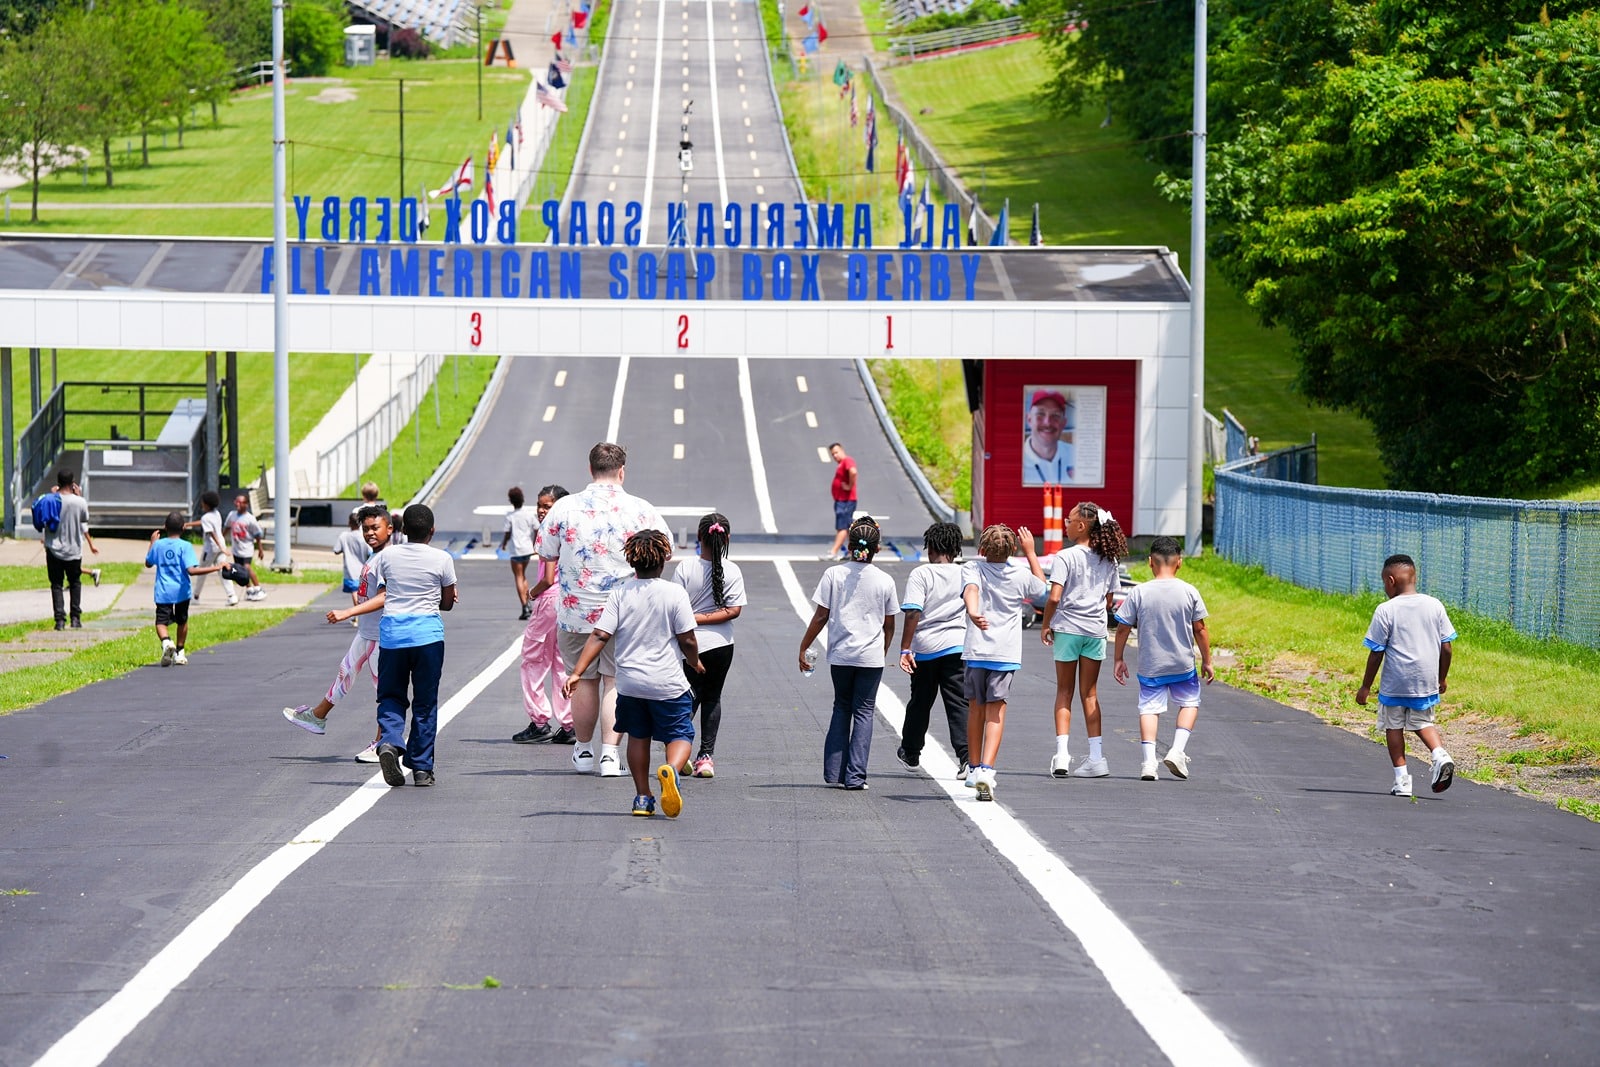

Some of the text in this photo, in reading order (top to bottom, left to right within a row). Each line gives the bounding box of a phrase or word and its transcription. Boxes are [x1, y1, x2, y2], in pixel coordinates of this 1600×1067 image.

[261, 246, 981, 301] ALL AMERICAN SOAP BOX DERBY
[471, 312, 482, 347] 3
[678, 314, 689, 348] 2
[886, 315, 894, 350] 1
